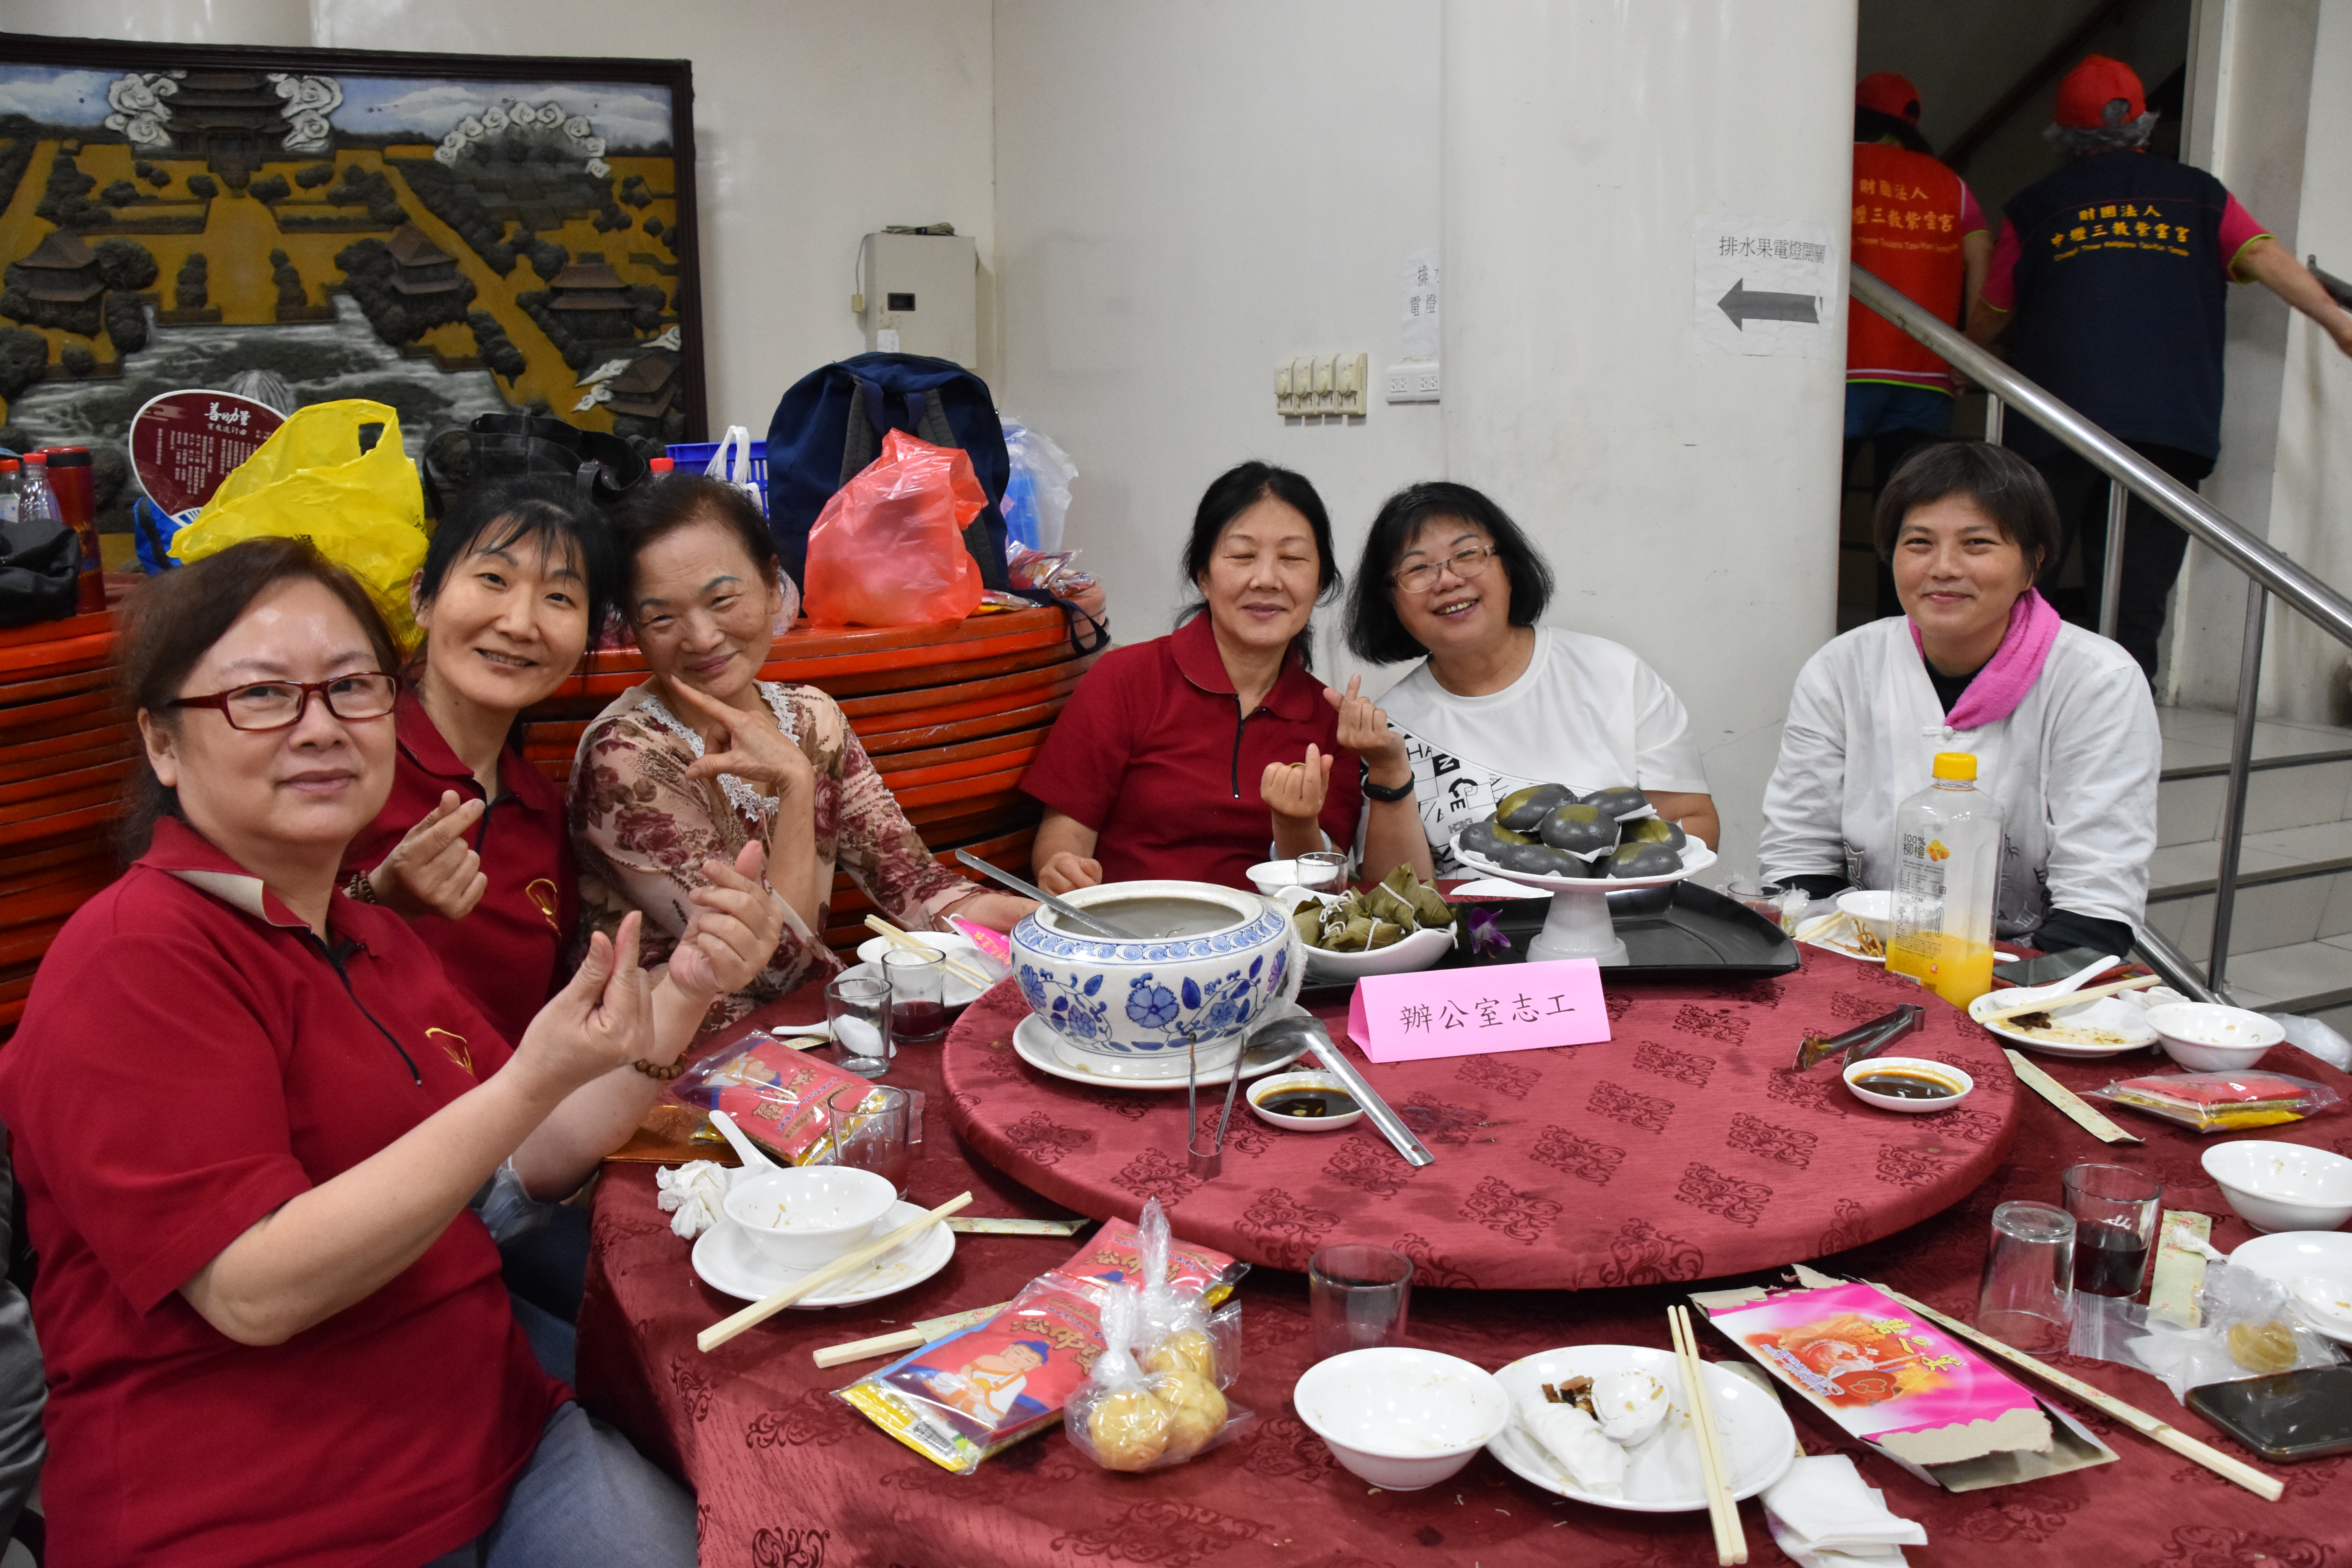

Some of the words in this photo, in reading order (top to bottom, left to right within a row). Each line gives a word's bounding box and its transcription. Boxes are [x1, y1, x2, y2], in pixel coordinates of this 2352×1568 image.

[1719, 236, 1826, 263] 排水果電燈開關
[1410, 294, 1436, 316] 電燈
[204, 402, 251, 426] 善的力量
[1903, 842, 1925, 859] 柳橙
[1904, 833, 1925, 846] 100%
[1399, 993, 1575, 1034] 辦公室志工
